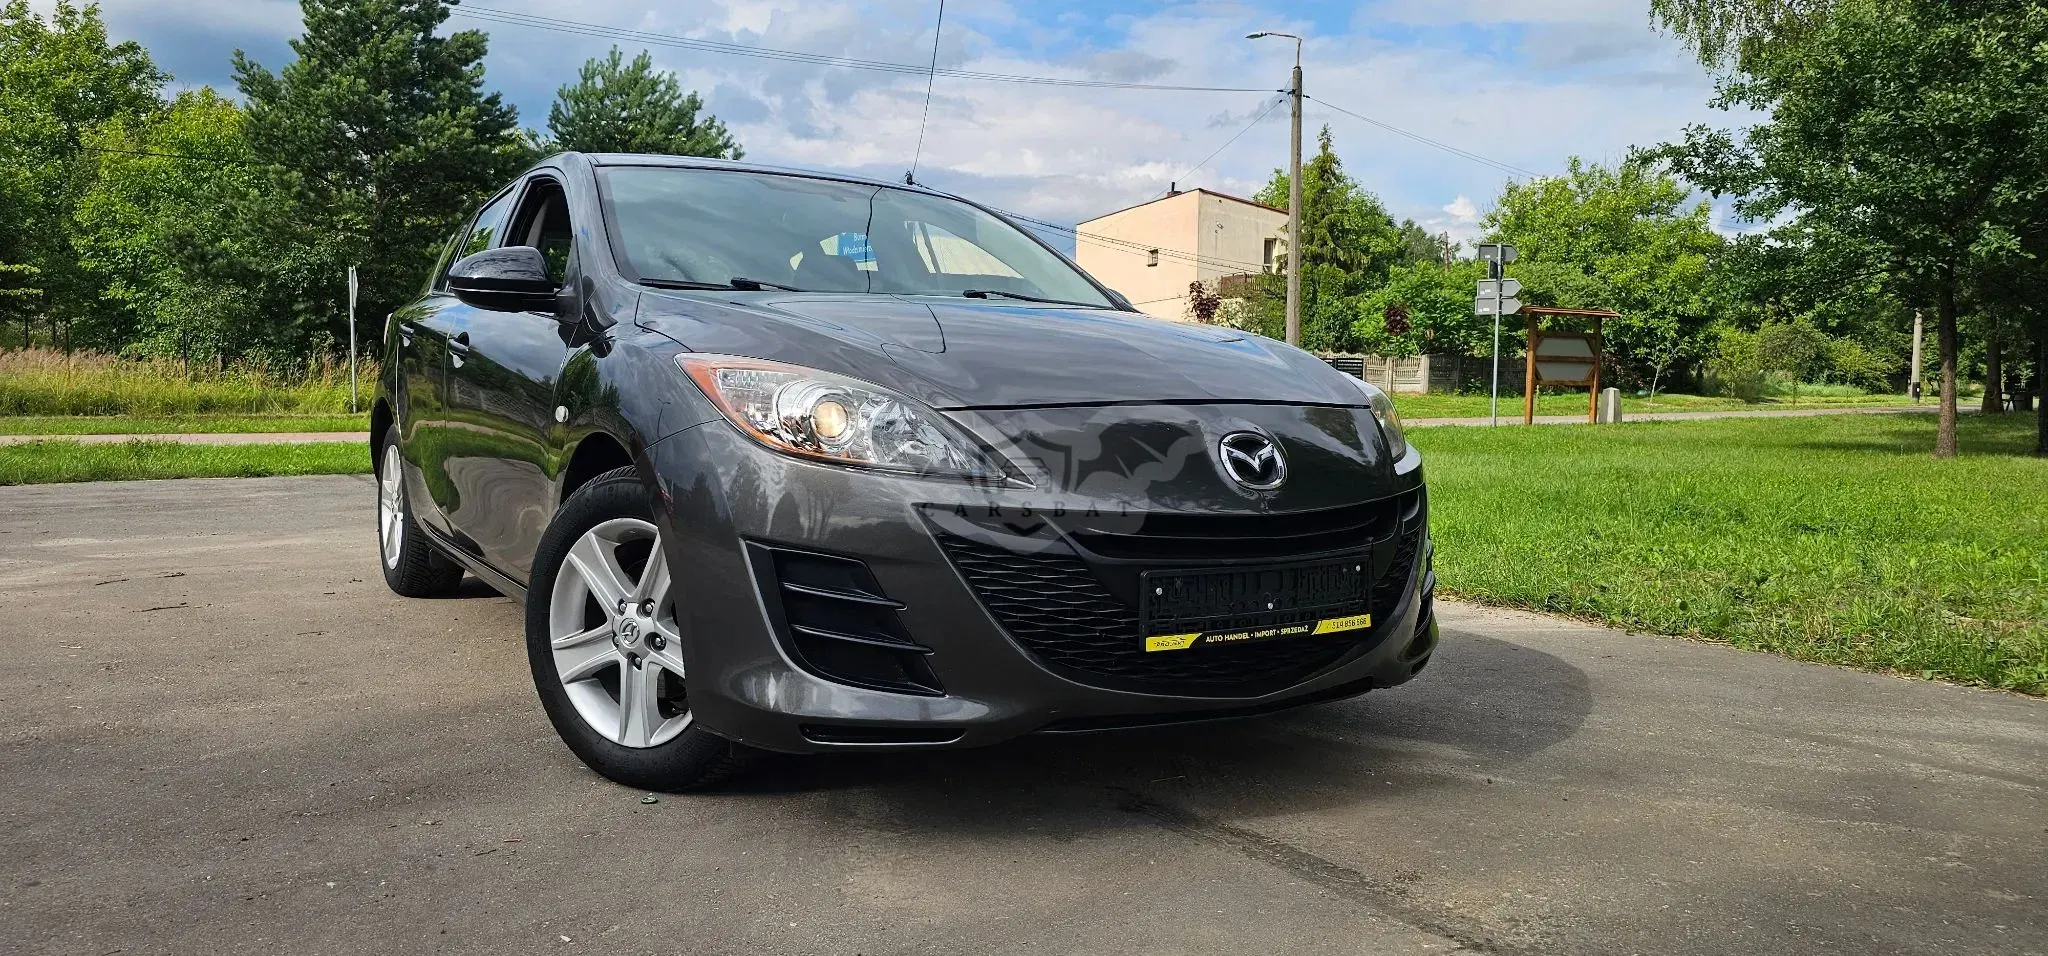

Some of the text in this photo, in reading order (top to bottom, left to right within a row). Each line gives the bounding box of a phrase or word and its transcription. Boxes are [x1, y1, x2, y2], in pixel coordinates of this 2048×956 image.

[1205, 624, 1309, 643] AUTO HANDEL IMPORT SPRZEDAŻ
